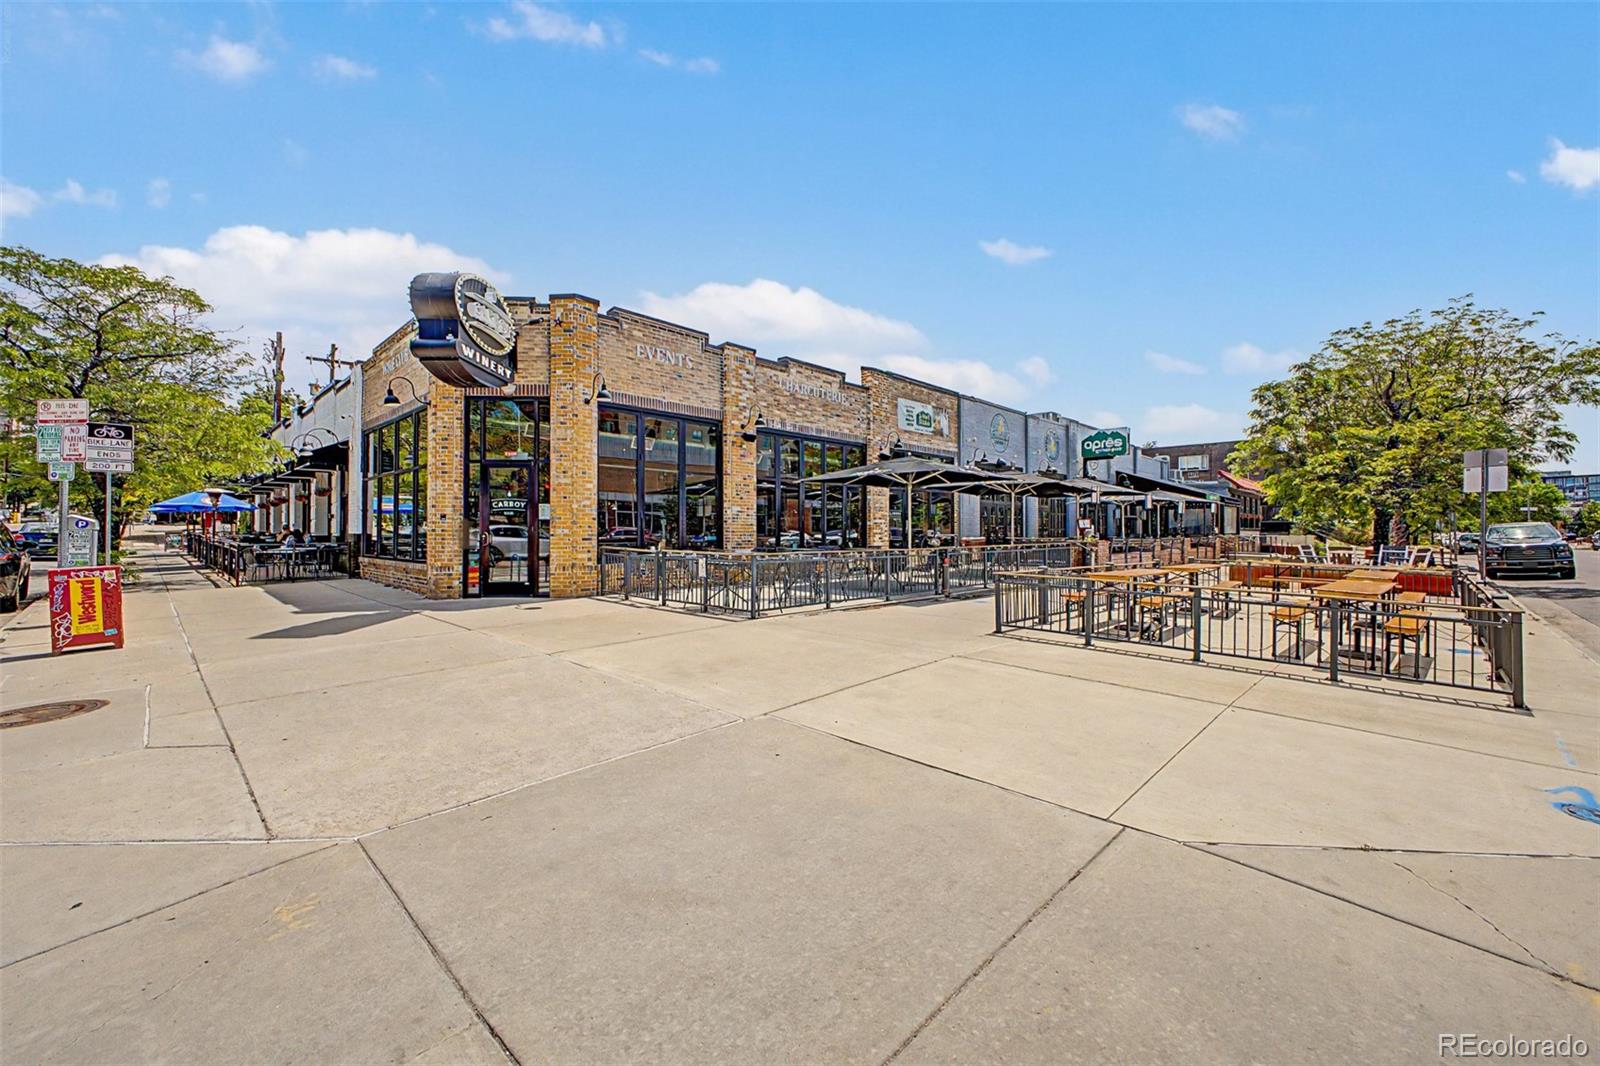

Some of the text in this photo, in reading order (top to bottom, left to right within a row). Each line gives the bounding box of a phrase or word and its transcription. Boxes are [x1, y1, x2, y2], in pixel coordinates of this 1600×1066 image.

[461, 343, 513, 379] WINERY
[636, 343, 694, 369] EVENTS
[69, 427, 80, 435] NO
[110, 439, 130, 447] LANE
[1084, 437, 1123, 451] aprês
[96, 450, 121, 458] ENDS
[92, 462, 111, 470] 200
[76, 579, 97, 625] Westword
